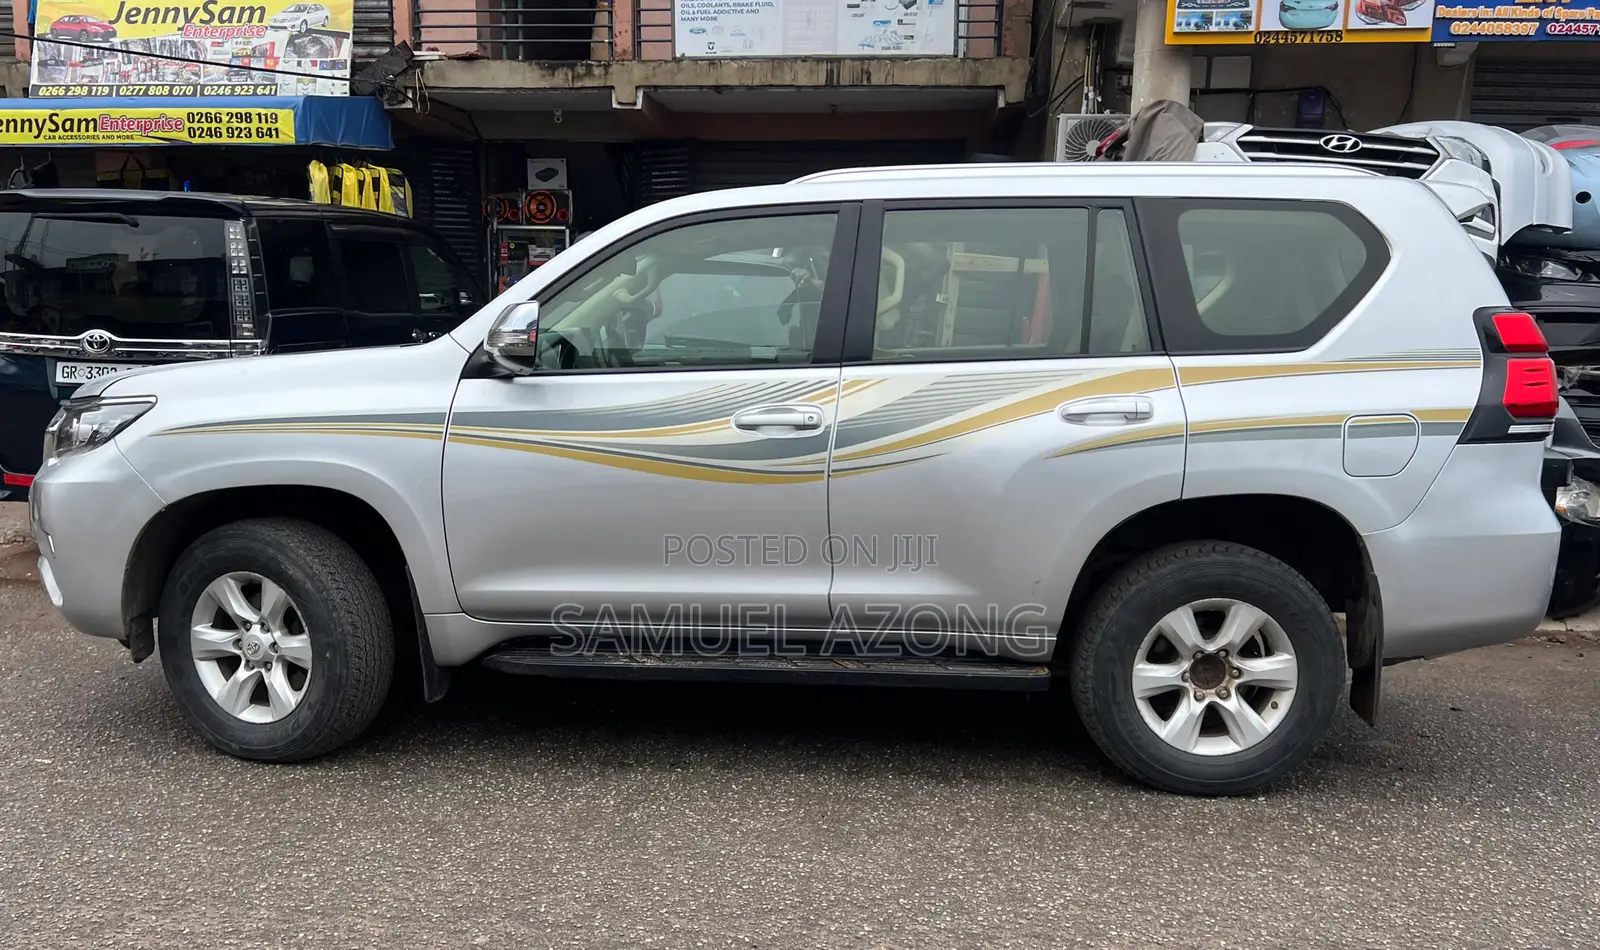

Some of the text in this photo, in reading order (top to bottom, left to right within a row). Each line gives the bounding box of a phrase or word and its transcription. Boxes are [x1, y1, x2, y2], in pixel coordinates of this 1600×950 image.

[108, 0, 267, 31] JennySam
[1435, 5, 1479, 19] Dealers
[1479, 5, 1494, 18] in:
[1495, 5, 1511, 18] All
[1510, 5, 1541, 19] Kinds
[1542, 6, 1555, 19] of
[1555, 6, 1586, 21] Spare
[182, 24, 267, 40] Enterprise
[1451, 21, 1600, 36] 0244058397 024457
[1254, 30, 1343, 44] 0244571758
[38, 85, 277, 96] 0266 298 119 0277 808 070 0246 923 641
[99, 114, 185, 136] Enterprise
[187, 112, 279, 124] 0266 298 119
[187, 127, 280, 139] 0246 923 641
[62, 365, 77, 379] GR
